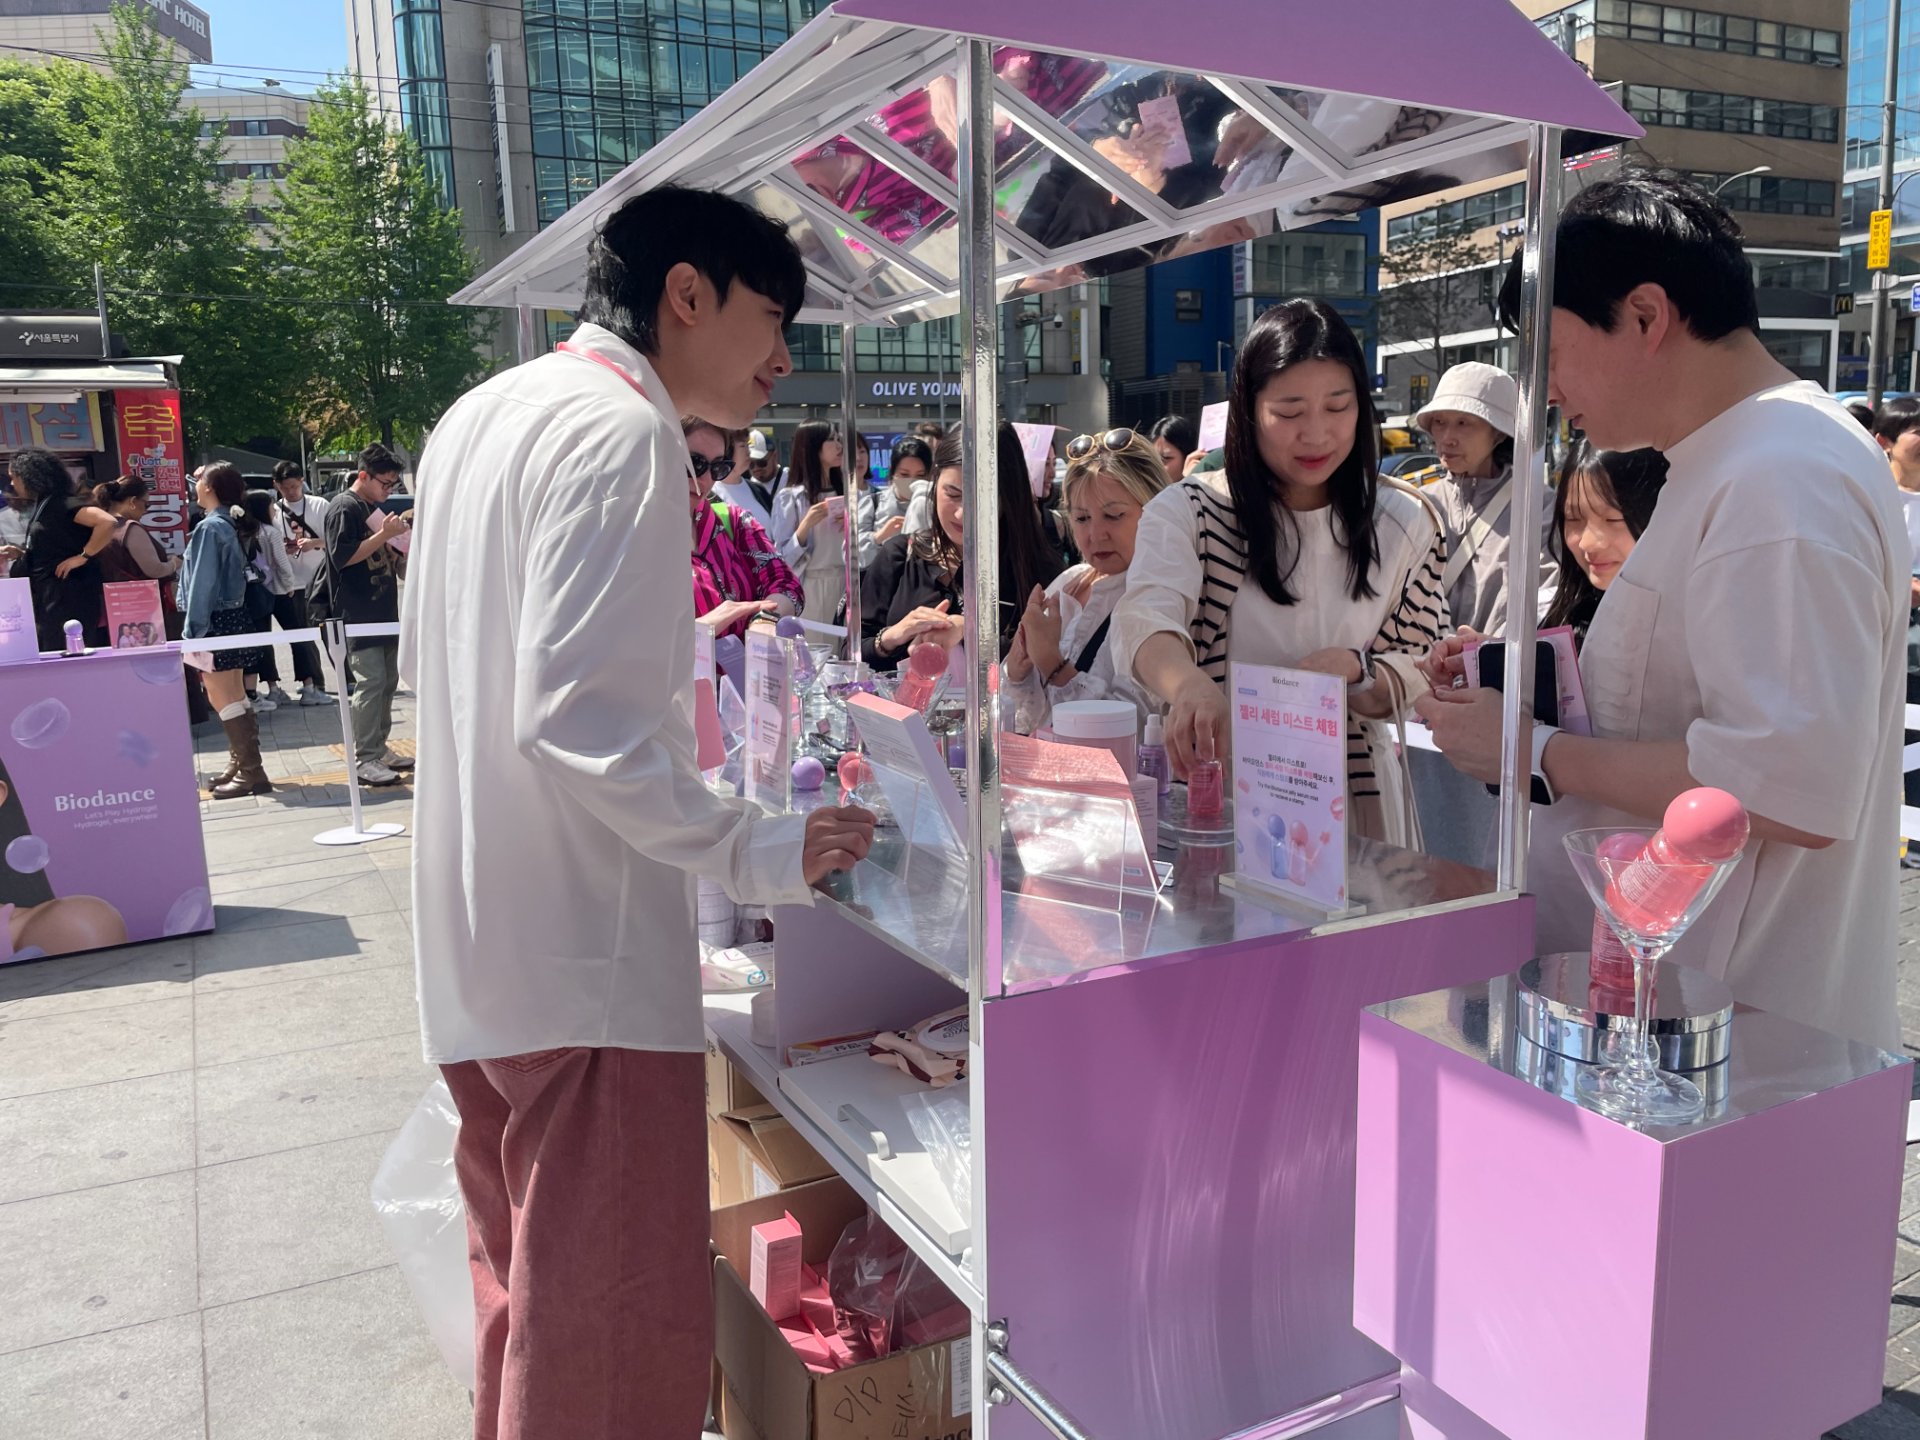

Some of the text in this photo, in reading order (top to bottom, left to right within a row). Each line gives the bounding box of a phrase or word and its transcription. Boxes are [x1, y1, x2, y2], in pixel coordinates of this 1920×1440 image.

[174, 5, 207, 38] HOTEL
[34, 333, 79, 344] 서울특별시
[872, 382, 917, 396] OLIVE
[124, 405, 175, 443] 축
[1261, 708, 1280, 726] 세럼
[1282, 712, 1313, 731] 미스트
[1316, 718, 1337, 737] 체험
[55, 788, 155, 812] Biodance
